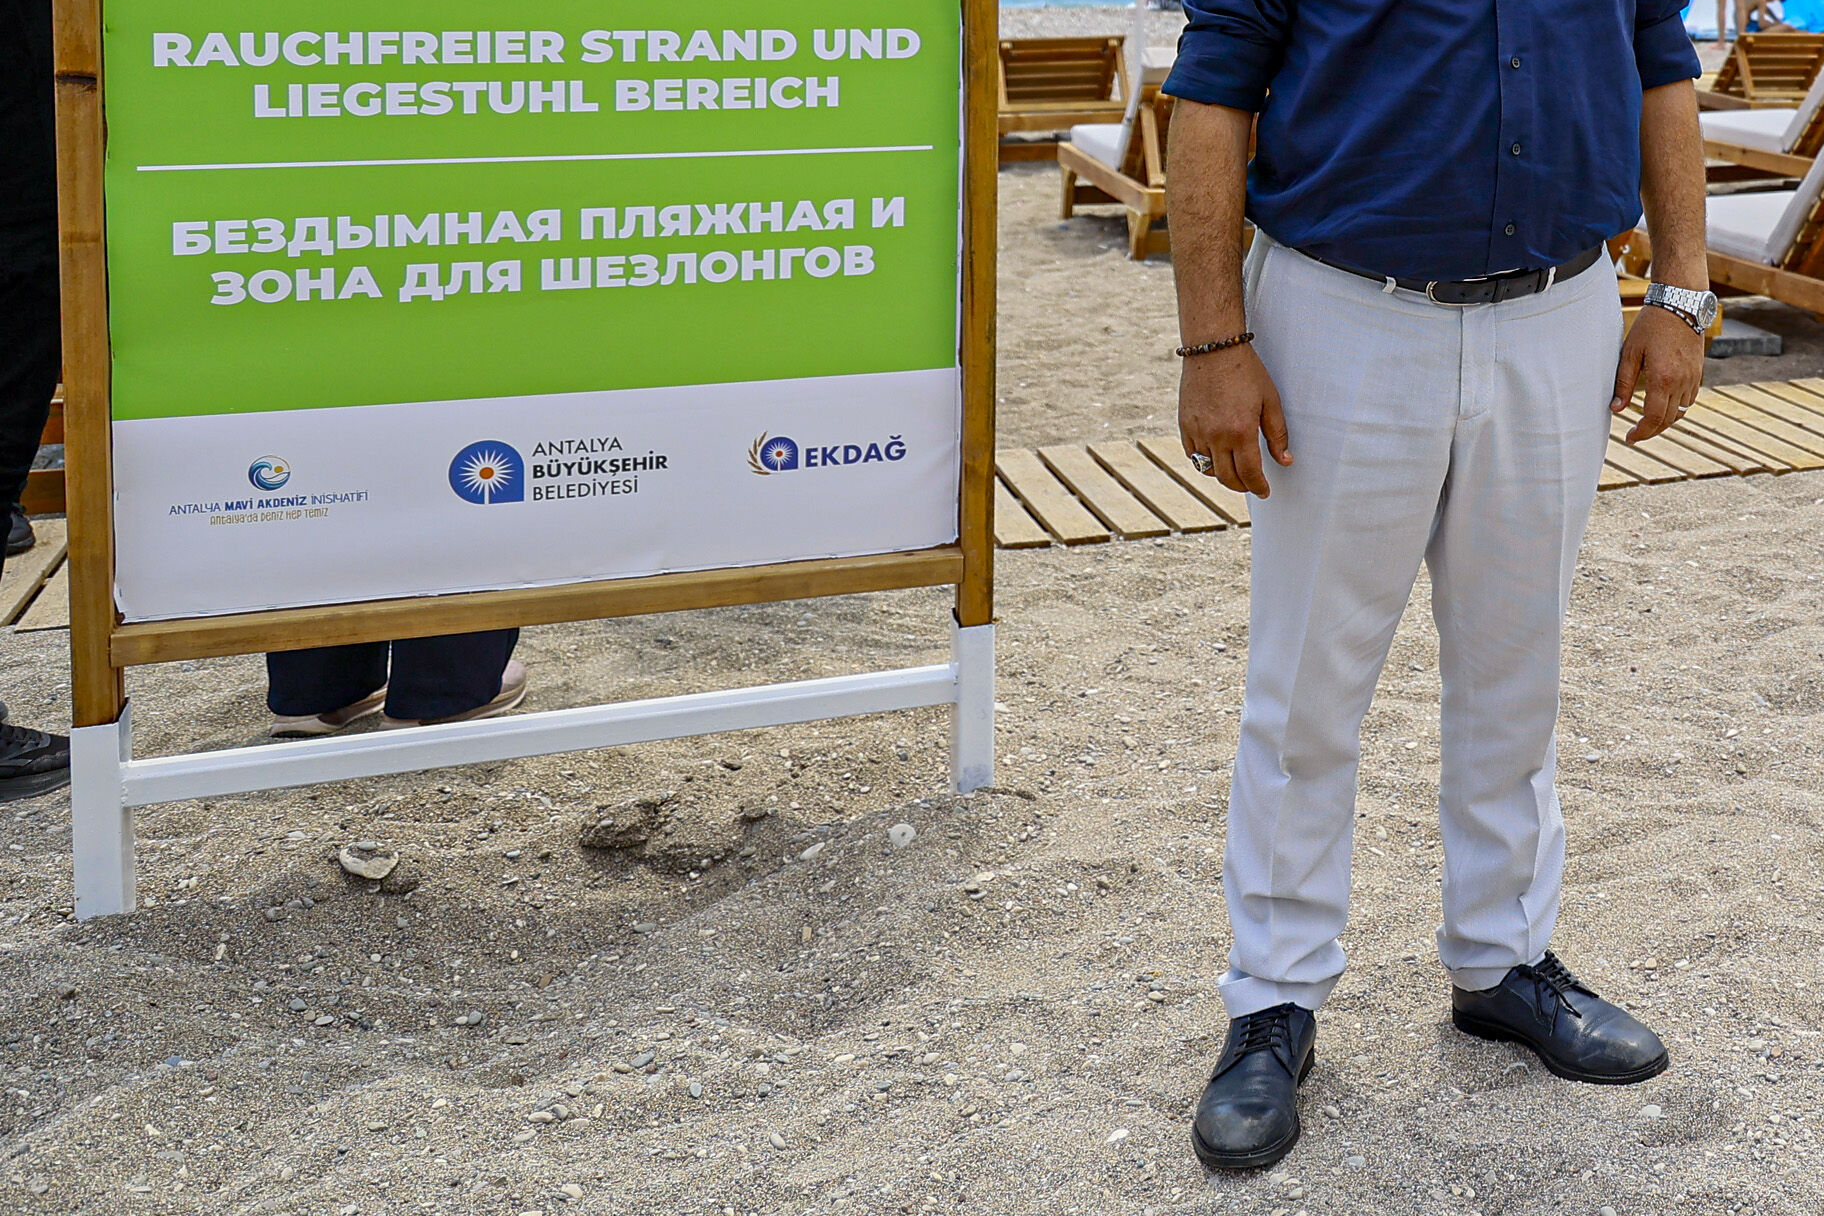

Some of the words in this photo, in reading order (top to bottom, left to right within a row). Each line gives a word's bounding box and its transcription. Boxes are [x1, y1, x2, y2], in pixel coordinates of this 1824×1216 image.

[151, 30, 566, 68] RAUCHFREIER
[580, 28, 799, 64] STRAND
[812, 28, 922, 61] UND
[253, 79, 600, 119] LIEGESTUHL
[614, 76, 840, 113] BEREICH
[171, 208, 562, 259] БЕЗДЫМНАЯ
[580, 198, 856, 241] ПЛЯЖНАЯ
[870, 196, 906, 229] И
[210, 266, 384, 306] ЗОНА
[398, 259, 522, 304] ДЛЯ
[540, 245, 877, 292] ШЕЗЛОНГОВ
[532, 436, 623, 457] ANTALYA
[805, 434, 906, 468] EKDAĞ
[532, 450, 669, 479] BÜYÜKŞEHİR
[169, 503, 221, 516] ANTALYA
[224, 497, 254, 512] MAVİ
[257, 494, 307, 510] AKDENİZ
[532, 475, 639, 501] BELEDİYESİ
